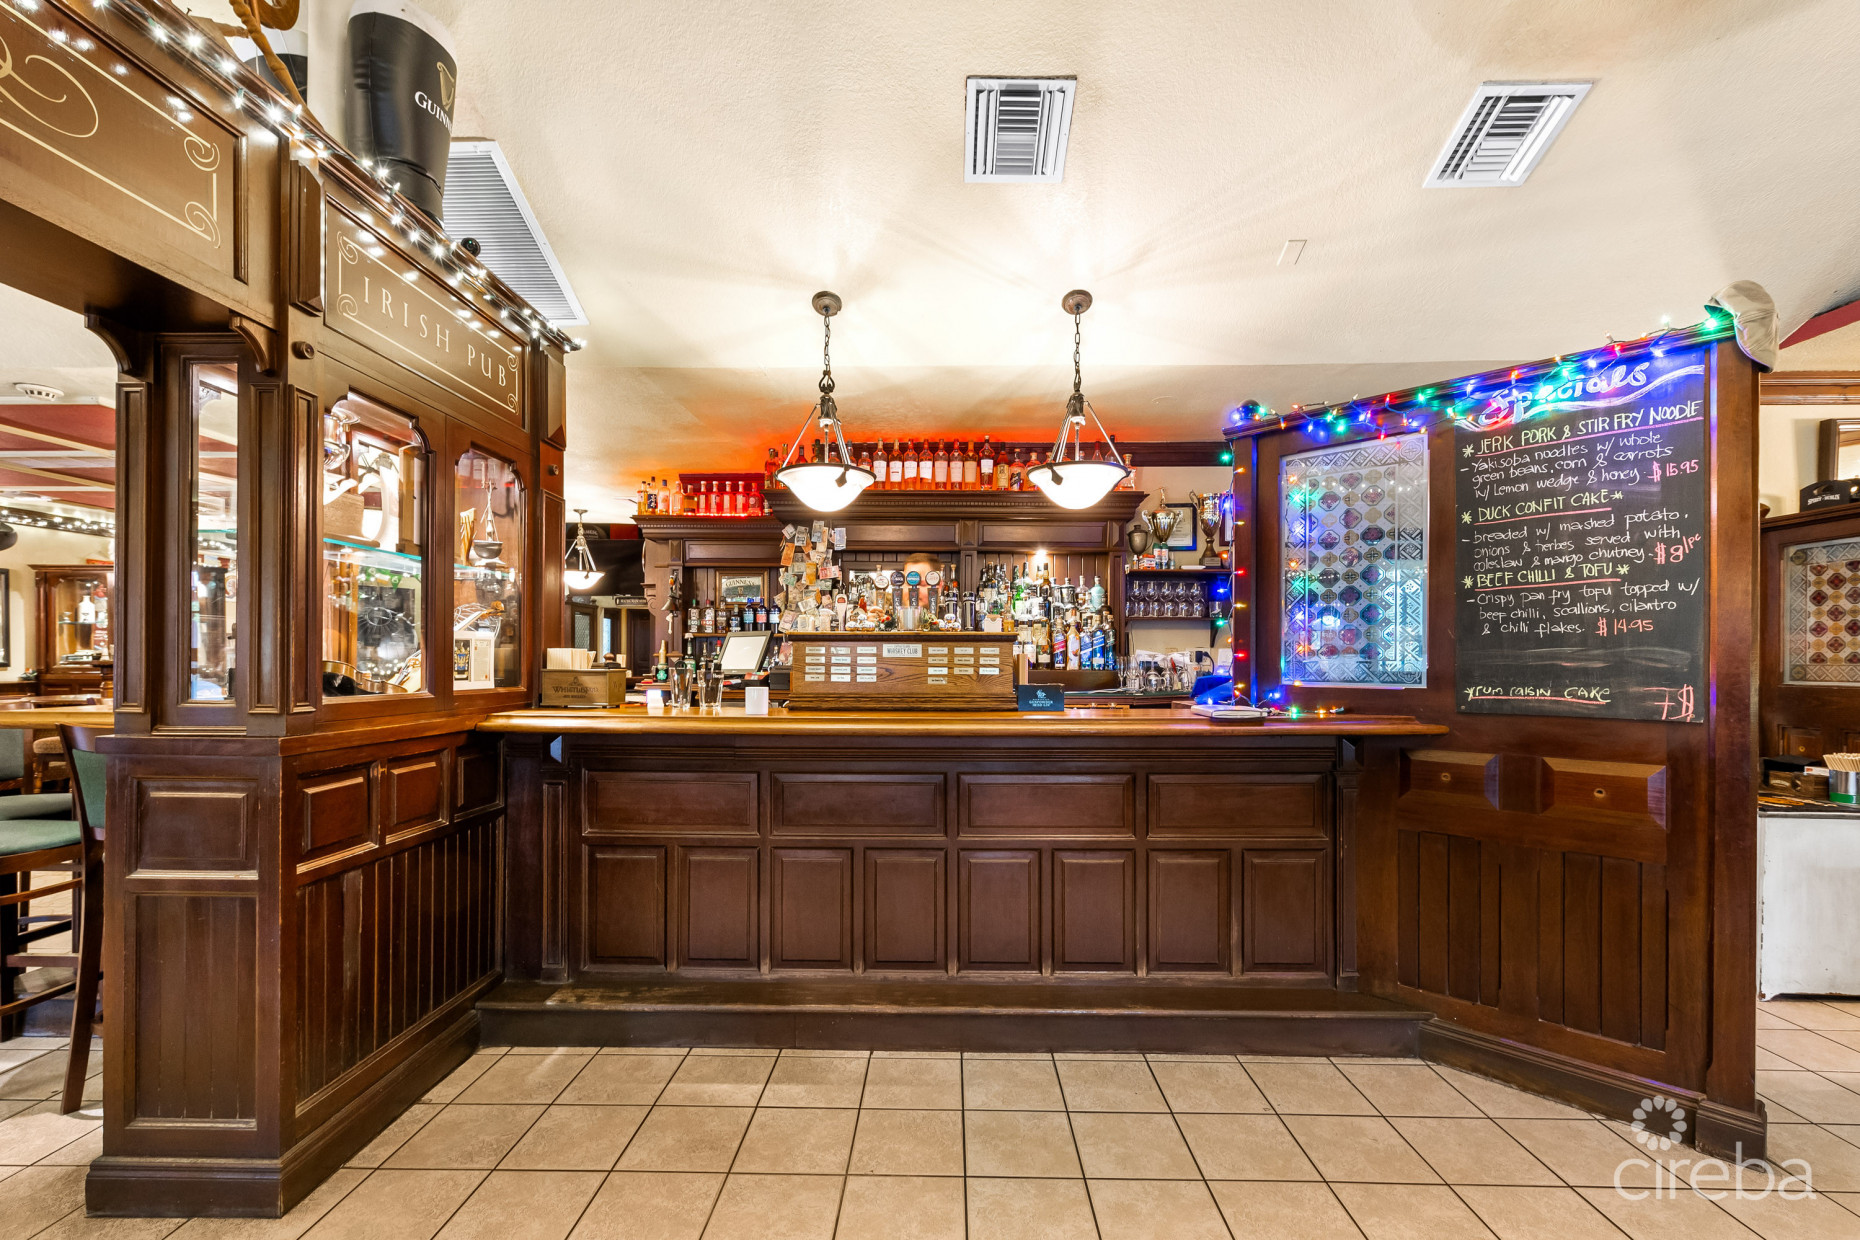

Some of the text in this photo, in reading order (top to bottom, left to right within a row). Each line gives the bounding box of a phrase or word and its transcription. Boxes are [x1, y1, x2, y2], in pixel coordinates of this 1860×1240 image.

[363, 276, 506, 387] IRISH PUB
[1477, 400, 1704, 455] JERK PORK & STIR FRY NOODLE
[1535, 444, 1589, 461] noodles
[1620, 431, 1664, 447] whole
[1472, 472, 1505, 490] green
[1554, 457, 1588, 470] corn
[1592, 453, 1608, 470] &
[1613, 444, 1675, 461] carrots
[1494, 483, 1529, 496] Lemon
[1536, 473, 1580, 491] wedge
[1586, 469, 1597, 486] &
[1601, 467, 1640, 486] honey
[1478, 504, 1512, 521] DUCK
[1515, 496, 1566, 515] CONFIT
[1473, 525, 1528, 543] breaded
[1559, 513, 1615, 532] mashed
[1473, 545, 1511, 559] onions
[1522, 541, 1532, 555] &
[1584, 531, 1631, 546] served
[1644, 524, 1681, 539] with
[1477, 562, 1613, 587] BEEF CHILLI & TOFU
[1530, 556, 1541, 568] &
[1544, 554, 1584, 568] mango
[1520, 591, 1545, 608] pan
[1548, 589, 1571, 606] fry
[1579, 585, 1612, 602] tofu
[1620, 579, 1670, 598] topped
[1480, 606, 1507, 624] beef
[1619, 598, 1677, 612] cilantro
[1481, 622, 1491, 636] &
[1500, 621, 1530, 633] chilli
[887, 647, 919, 655] WHISKEY CLUB
